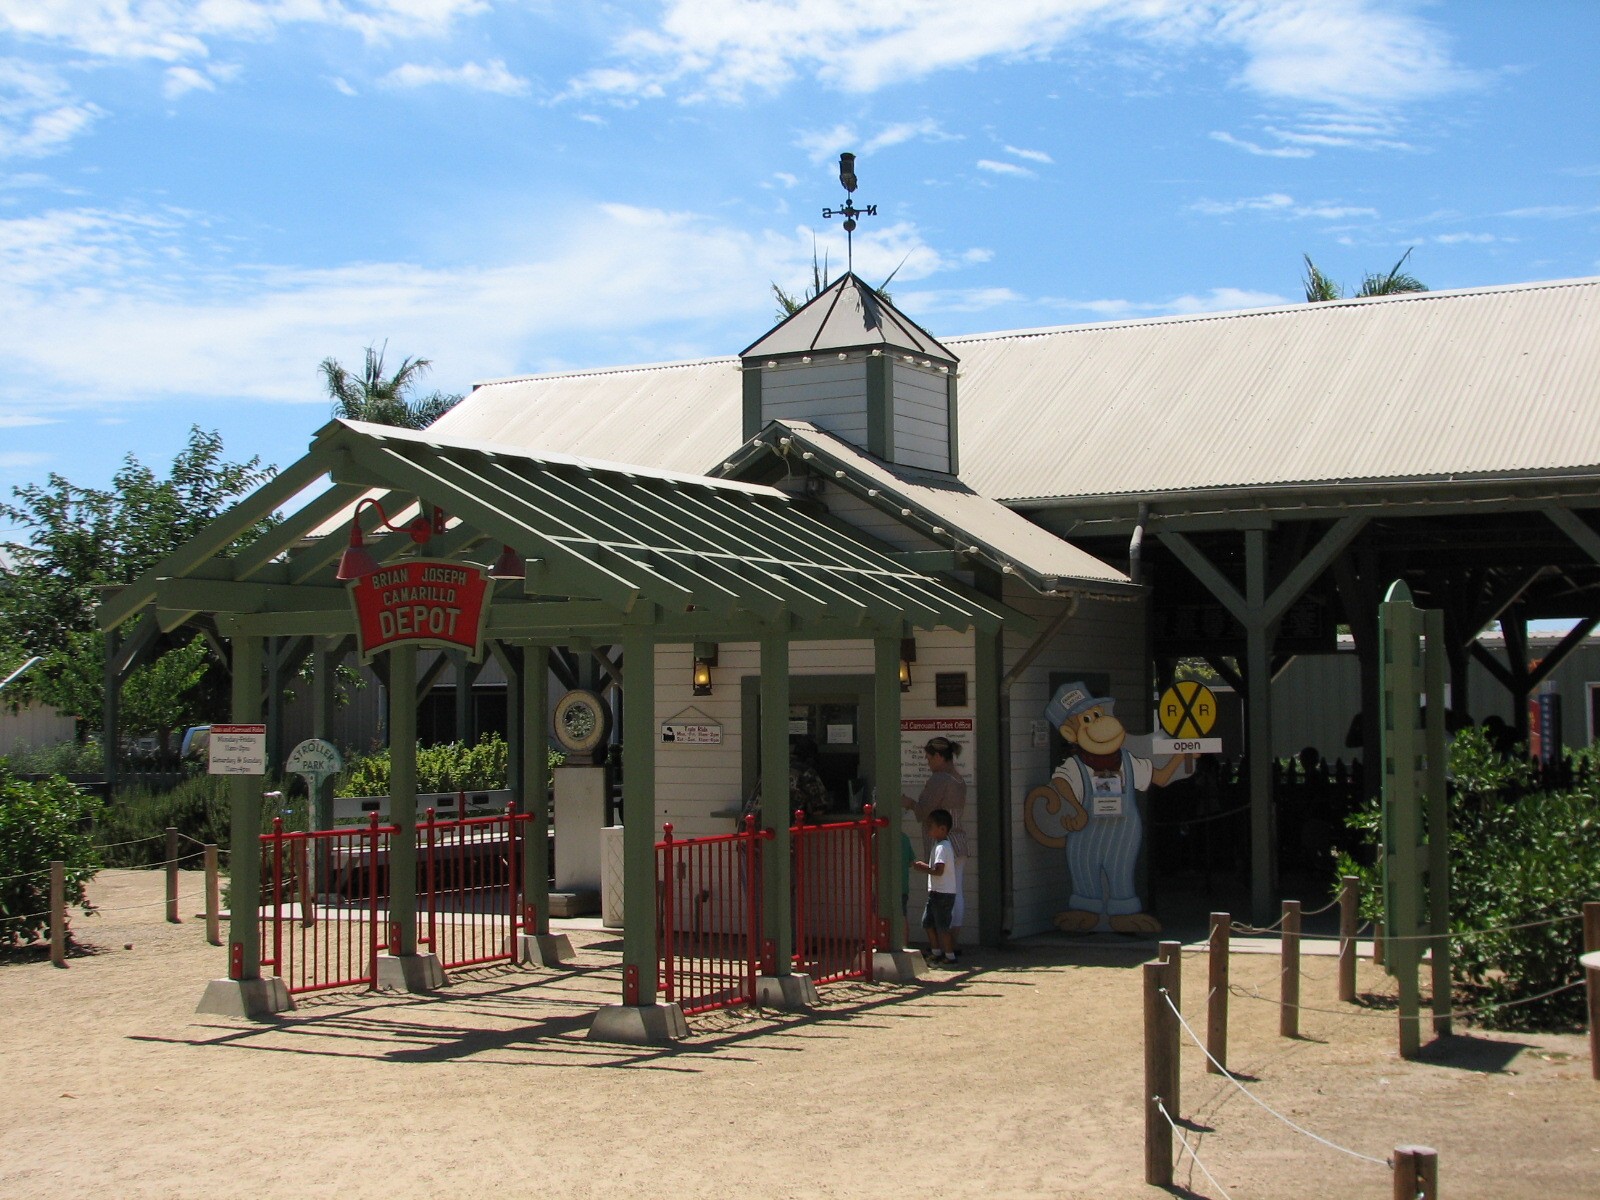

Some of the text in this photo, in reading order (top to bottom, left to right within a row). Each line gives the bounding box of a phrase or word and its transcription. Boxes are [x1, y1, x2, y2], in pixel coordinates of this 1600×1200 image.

[372, 567, 467, 590] BRIAN JOSEPH
[383, 586, 456, 606] CAMARILLO
[379, 605, 461, 639] DEPOT
[1167, 704, 1177, 717] R
[1199, 703, 1209, 716] R
[936, 721, 953, 730] Ticket
[954, 721, 971, 730] Office
[293, 742, 335, 763] STROLLER
[1174, 741, 1200, 752] open
[303, 760, 325, 770] PARK
